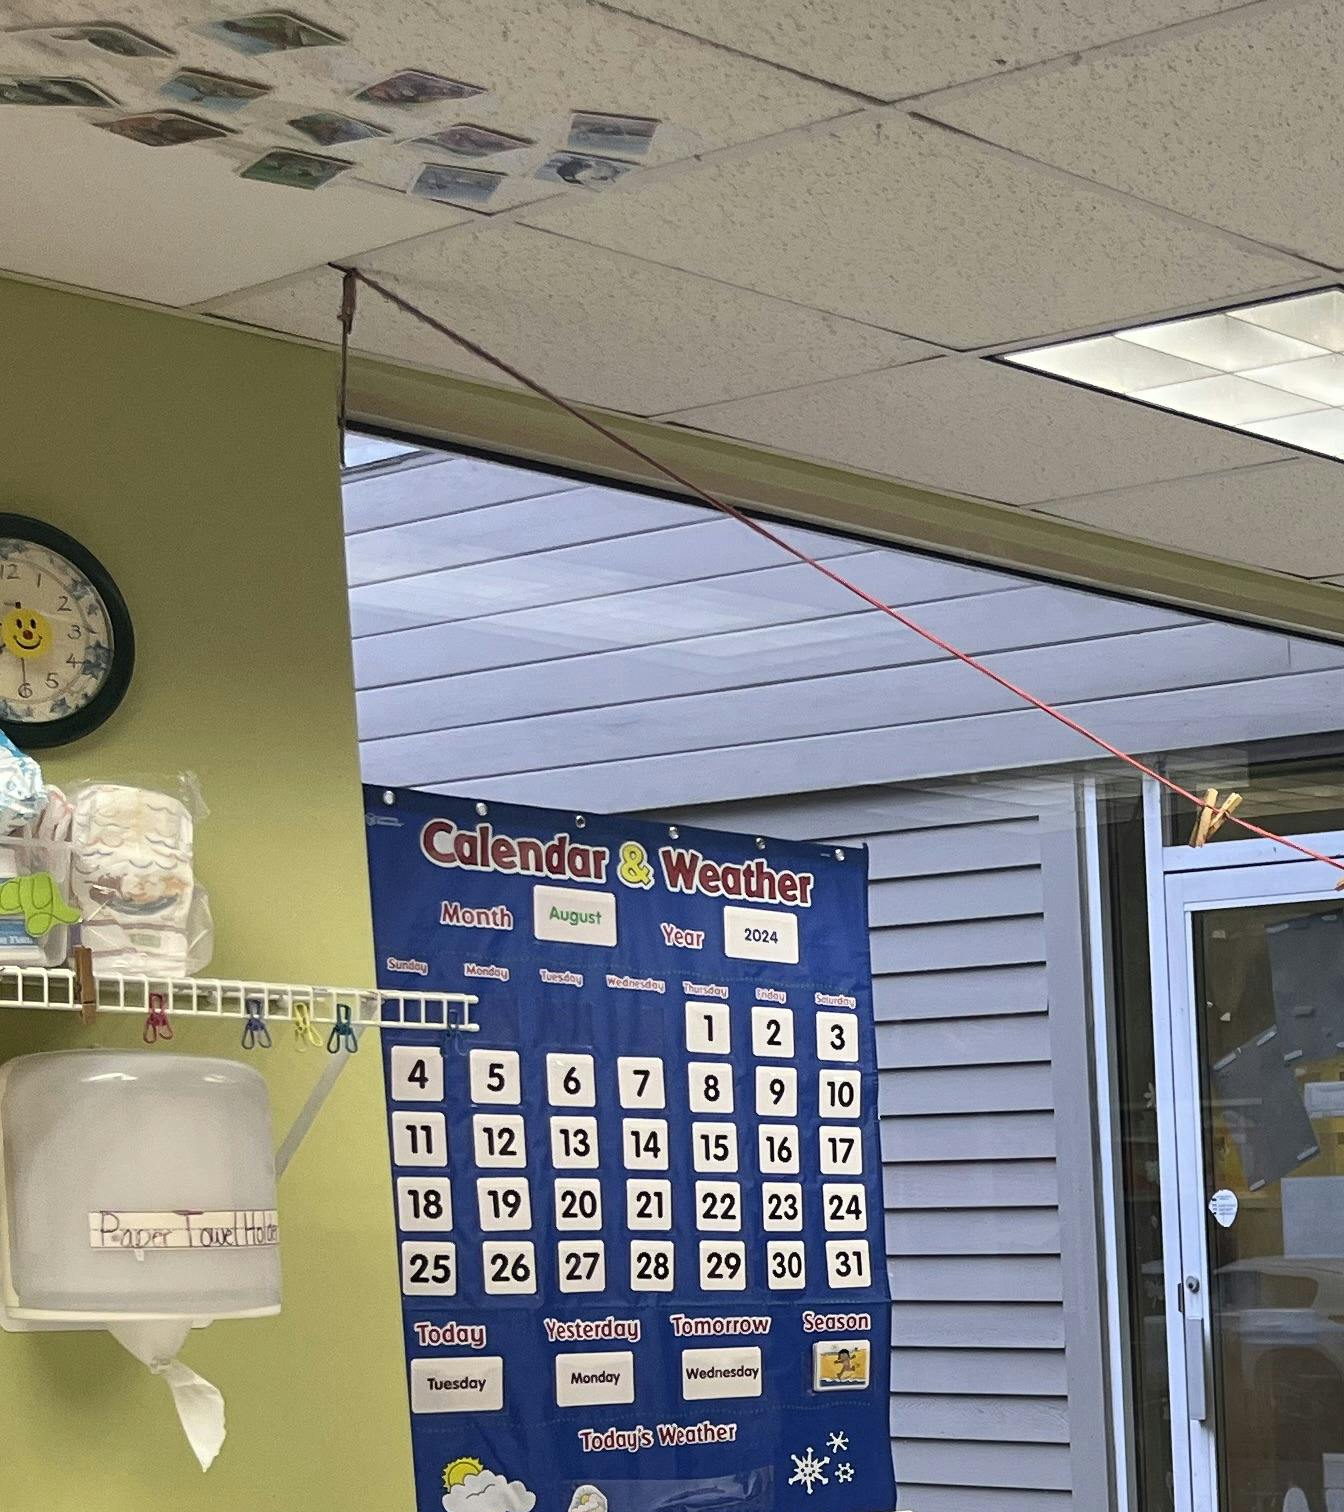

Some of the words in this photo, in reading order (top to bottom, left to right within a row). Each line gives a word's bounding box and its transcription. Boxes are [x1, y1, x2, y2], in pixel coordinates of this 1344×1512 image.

[57, 595, 72, 612] 2
[67, 624, 82, 640] 3
[65, 653, 79, 670] 4
[18, 682, 33, 699] 6
[45, 672, 59, 689] 5
[423, 819, 609, 881] Calendar
[617, 842, 655, 888] &
[660, 848, 813, 907] Weather
[441, 902, 514, 931] Month
[549, 906, 602, 927] August
[662, 923, 705, 950] Year
[744, 928, 779, 945] 2024
[388, 957, 429, 976] Sunday
[464, 963, 510, 983] Monday
[540, 969, 584, 988] Tuesday
[606, 975, 666, 994] Wednesday
[683, 981, 729, 999] Thursday
[756, 988, 787, 1004] Friday
[815, 993, 857, 1010] Saturday
[703, 1015, 714, 1041] 1
[767, 1020, 782, 1046] 2
[831, 1024, 846, 1050] 3
[408, 1059, 429, 1089] 4
[487, 1063, 506, 1092] 5
[563, 1066, 581, 1095] 6
[633, 1070, 650, 1098] 7
[704, 1074, 720, 1102] 8
[769, 1078, 785, 1105] 9
[827, 1080, 854, 1108] 10
[405, 1124, 435, 1155] 11
[483, 1127, 517, 1157] 12
[560, 1129, 591, 1158] 13
[630, 1130, 661, 1159] 14
[701, 1133, 730, 1161] 15
[766, 1135, 793, 1163] 16
[828, 1137, 855, 1163] 17
[407, 1188, 444, 1219] 18
[487, 1188, 522, 1218] 19
[561, 1188, 597, 1218] 20
[636, 1191, 665, 1219] 21
[701, 1192, 737, 1220] 22
[767, 1193, 799, 1221] 23
[828, 1193, 862, 1221] 24
[100, 1211, 172, 1249] Paper
[173, 1210, 239, 1248] Towel
[409, 1254, 451, 1284] 25
[490, 1253, 530, 1283] 26
[565, 1251, 600, 1281] 27
[636, 1252, 671, 1281] 28
[706, 1251, 742, 1280] 29
[771, 1251, 803, 1279] 30
[835, 1249, 864, 1278] 31
[415, 1321, 487, 1350] Today
[544, 1316, 641, 1344] Yesterday
[670, 1314, 772, 1338] Tomorrow
[803, 1311, 872, 1334] Season
[427, 1375, 487, 1393] Tuesday
[570, 1369, 620, 1387] Monday
[686, 1364, 760, 1382] Wednesday
[579, 1425, 654, 1453] Today's
[658, 1421, 738, 1447] Weather
